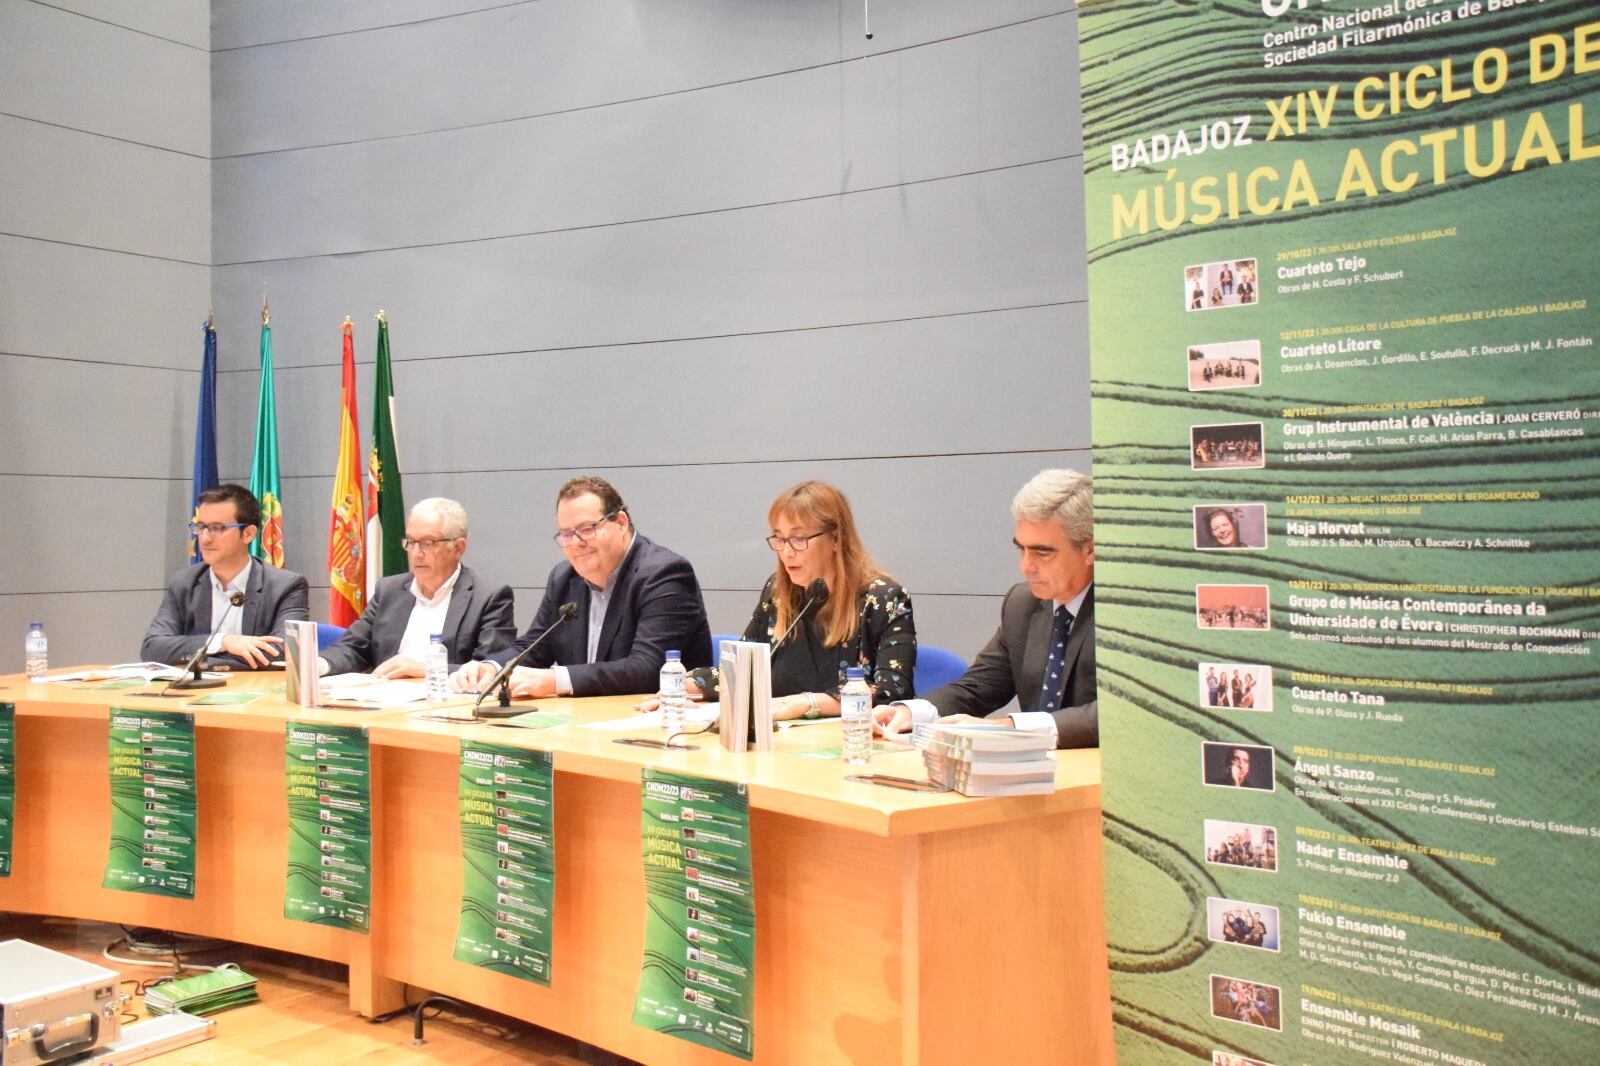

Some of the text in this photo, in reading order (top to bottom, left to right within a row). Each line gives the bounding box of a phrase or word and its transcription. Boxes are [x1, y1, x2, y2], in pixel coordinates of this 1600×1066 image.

[1263, 23, 1316, 48] Centro
[1322, 0, 1400, 33] Nacional
[1263, 2, 1482, 68] Sociedad Filarmónica de
[1265, 22, 1600, 141] XIV CICLO DE
[1112, 115, 1253, 172] BADAJOZ
[1112, 102, 1600, 240] MÚSICA ACTUAL
[1278, 256, 1366, 279] Cuarteto Tejo
[1278, 284, 1300, 293] Obras
[1300, 281, 1310, 290] de
[1364, 271, 1403, 282] Schubert
[1281, 342, 1336, 358] Cuarteto
[1281, 364, 1303, 373] Obras
[1304, 363, 1314, 371] de
[1482, 344, 1521, 355] Decruck
[1557, 336, 1592, 348] Fontán
[1284, 408, 1580, 436] Grup Instrumental de València JOAN CERVERÓ
[1284, 442, 1305, 450] Obras
[1307, 440, 1316, 448] de
[1452, 434, 1474, 442] Arias
[1521, 428, 1584, 438] Casablancas
[1287, 522, 1364, 536] Maja Horvat
[1377, 539, 1412, 548] Urquiza,
[1485, 538, 1530, 547] Schnittke
[1289, 595, 1546, 616] Grupo de Música Contemporânea da
[1290, 613, 1580, 638] Universidade de Évora CHRISTOPHER BOCHMANN
[1308, 634, 1340, 642] estrenos
[1342, 635, 1382, 644] absolutos
[1385, 636, 1395, 644] de
[1398, 636, 1409, 645] los
[1412, 636, 1449, 647] alumnos
[1451, 640, 1464, 648] del
[1467, 640, 1509, 651] Mestrado
[1512, 643, 1523, 651] de
[1526, 643, 1590, 655] Composición
[1292, 687, 1385, 706] Cuarteto Tana
[1292, 705, 1313, 714] Obras
[1316, 707, 1324, 715] de
[1294, 756, 1374, 780] Ángel Sanzo
[1295, 776, 1315, 786] Obras
[1496, 815, 1546, 829] Conciertos
[1548, 822, 1588, 835] Esteban
[647, 835, 681, 854] MÚSICA
[1296, 840, 1408, 870] Nadar Ensemble
[649, 853, 683, 870] ACTUAL
[1299, 908, 1406, 940] Fukio Ensemble
[1301, 999, 1420, 1039] Ensemble Mosaik
[1326, 1023, 1353, 1037] POPPE
[1397, 1040, 1439, 1058] ROBERTO
